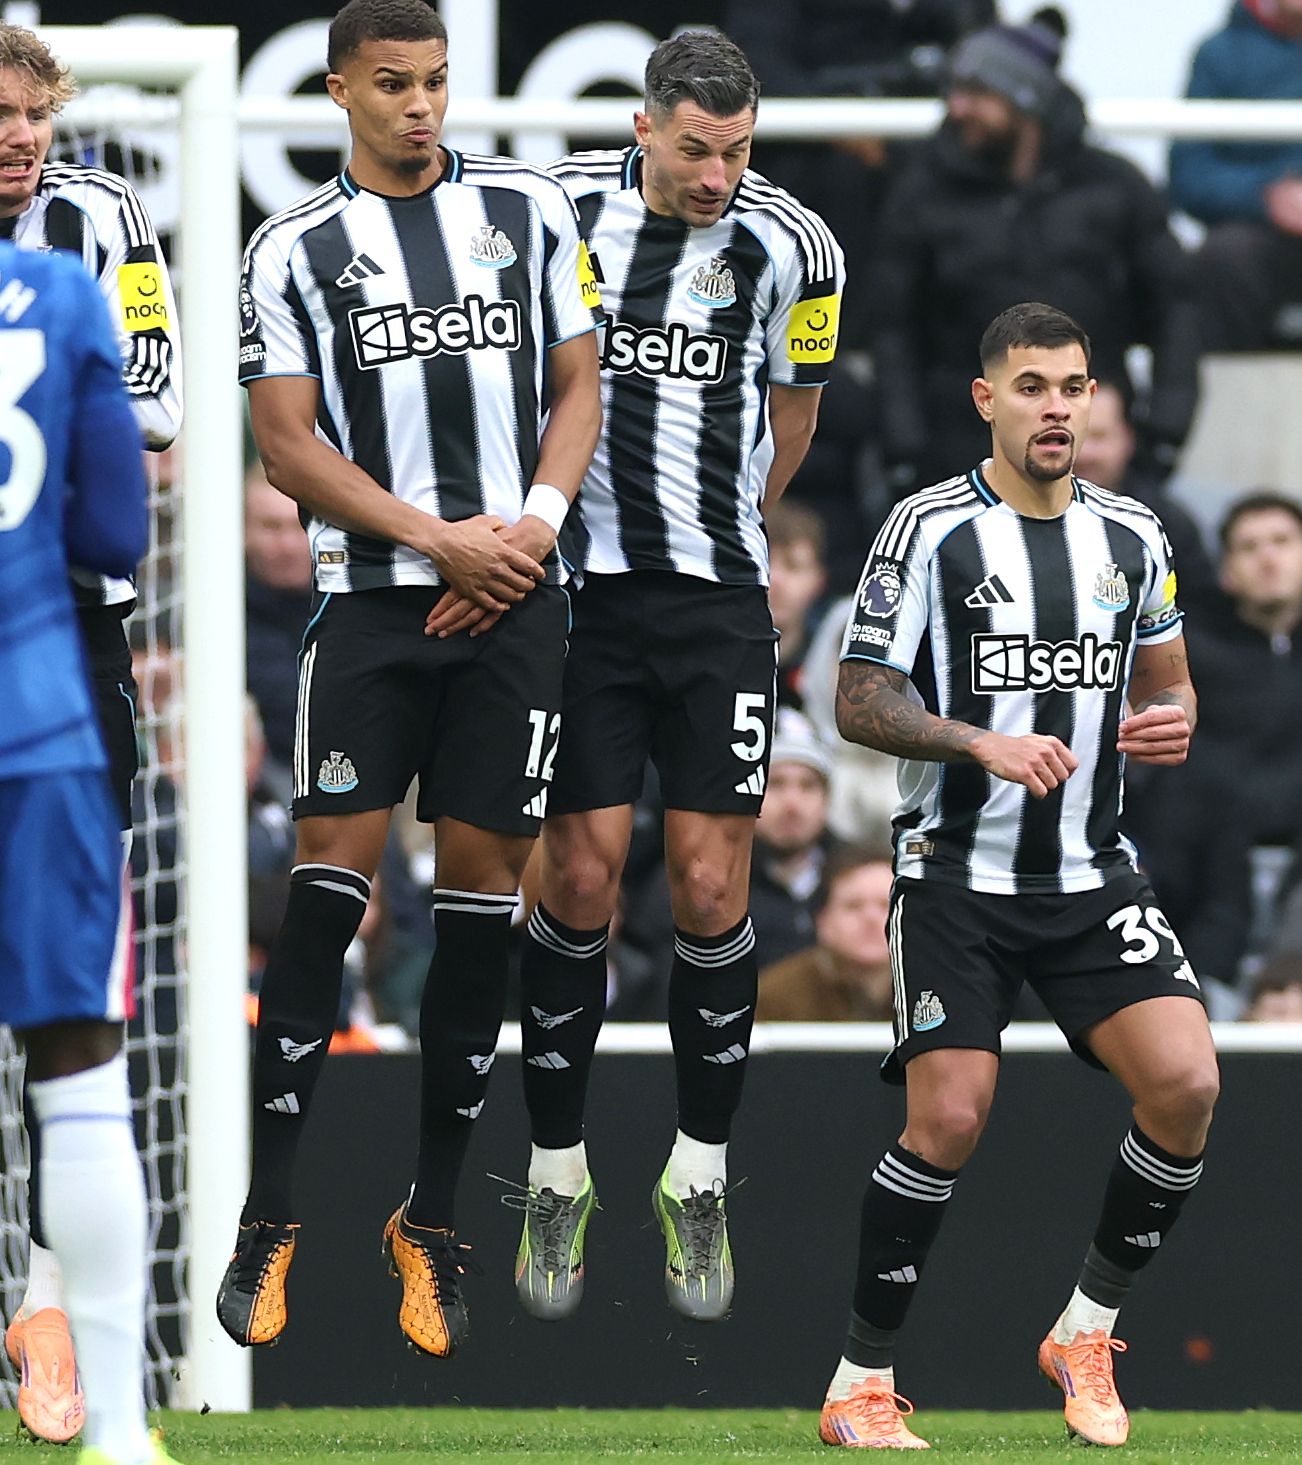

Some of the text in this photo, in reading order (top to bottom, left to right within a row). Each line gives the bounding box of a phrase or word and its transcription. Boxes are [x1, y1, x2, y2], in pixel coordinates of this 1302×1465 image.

[409, 299, 517, 351] sela
[608, 328, 720, 376] sela
[1028, 638, 1118, 685] sela
[525, 709, 562, 782] 12
[730, 692, 766, 762] 5
[1106, 904, 1185, 964] 39
